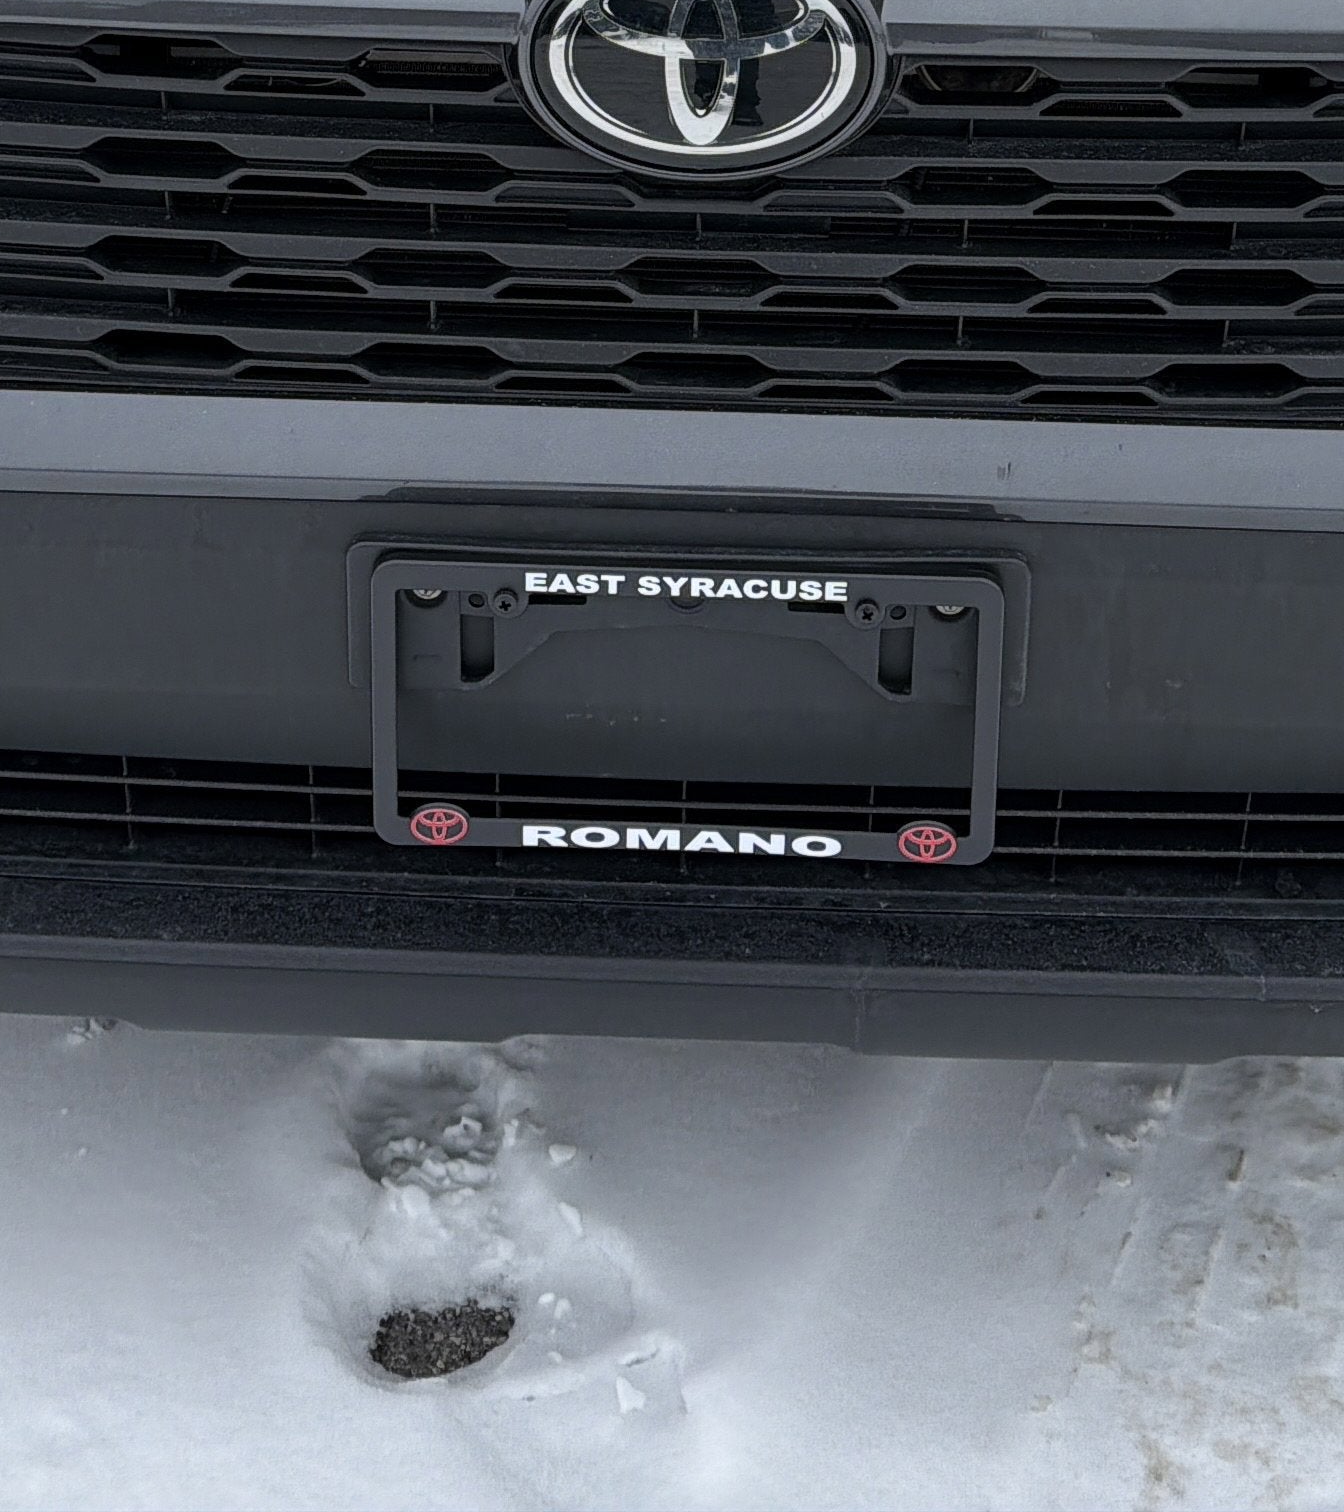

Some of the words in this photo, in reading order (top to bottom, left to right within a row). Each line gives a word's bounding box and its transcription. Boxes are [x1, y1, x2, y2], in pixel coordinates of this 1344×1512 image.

[524, 572, 625, 595] EAST
[637, 576, 848, 602] SYRACUSE
[522, 825, 843, 858] ROMANO
